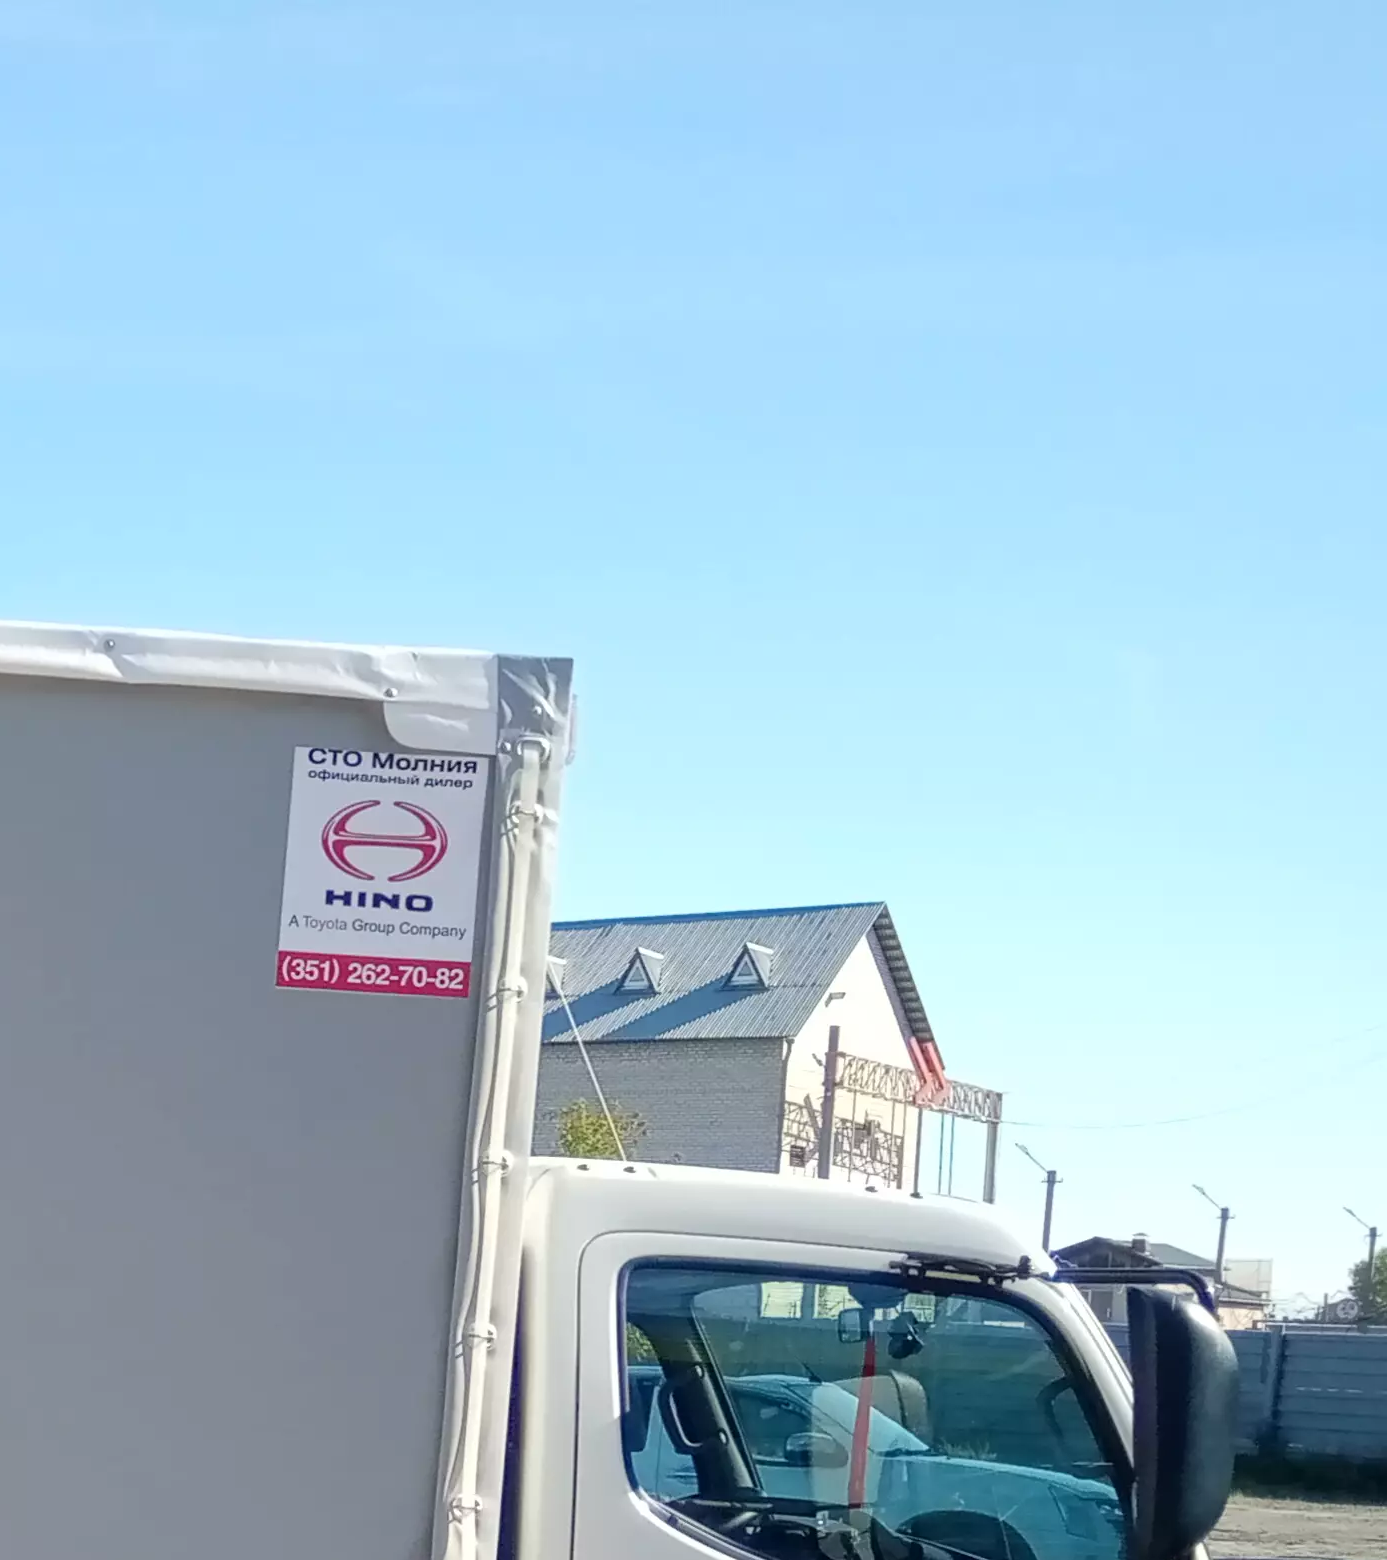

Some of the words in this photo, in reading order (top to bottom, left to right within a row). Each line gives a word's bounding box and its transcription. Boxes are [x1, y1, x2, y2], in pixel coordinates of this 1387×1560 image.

[308, 747, 363, 767] СТО
[372, 752, 478, 774] Молния
[308, 769, 420, 786] официальный
[423, 777, 474, 790] дилер
[325, 889, 434, 913] HINO
[288, 914, 300, 928] A
[303, 915, 348, 932] Toyota
[351, 918, 396, 936] Group
[399, 921, 467, 941] Company
[282, 955, 340, 984] (351)
[346, 961, 465, 990] 262-70-82
